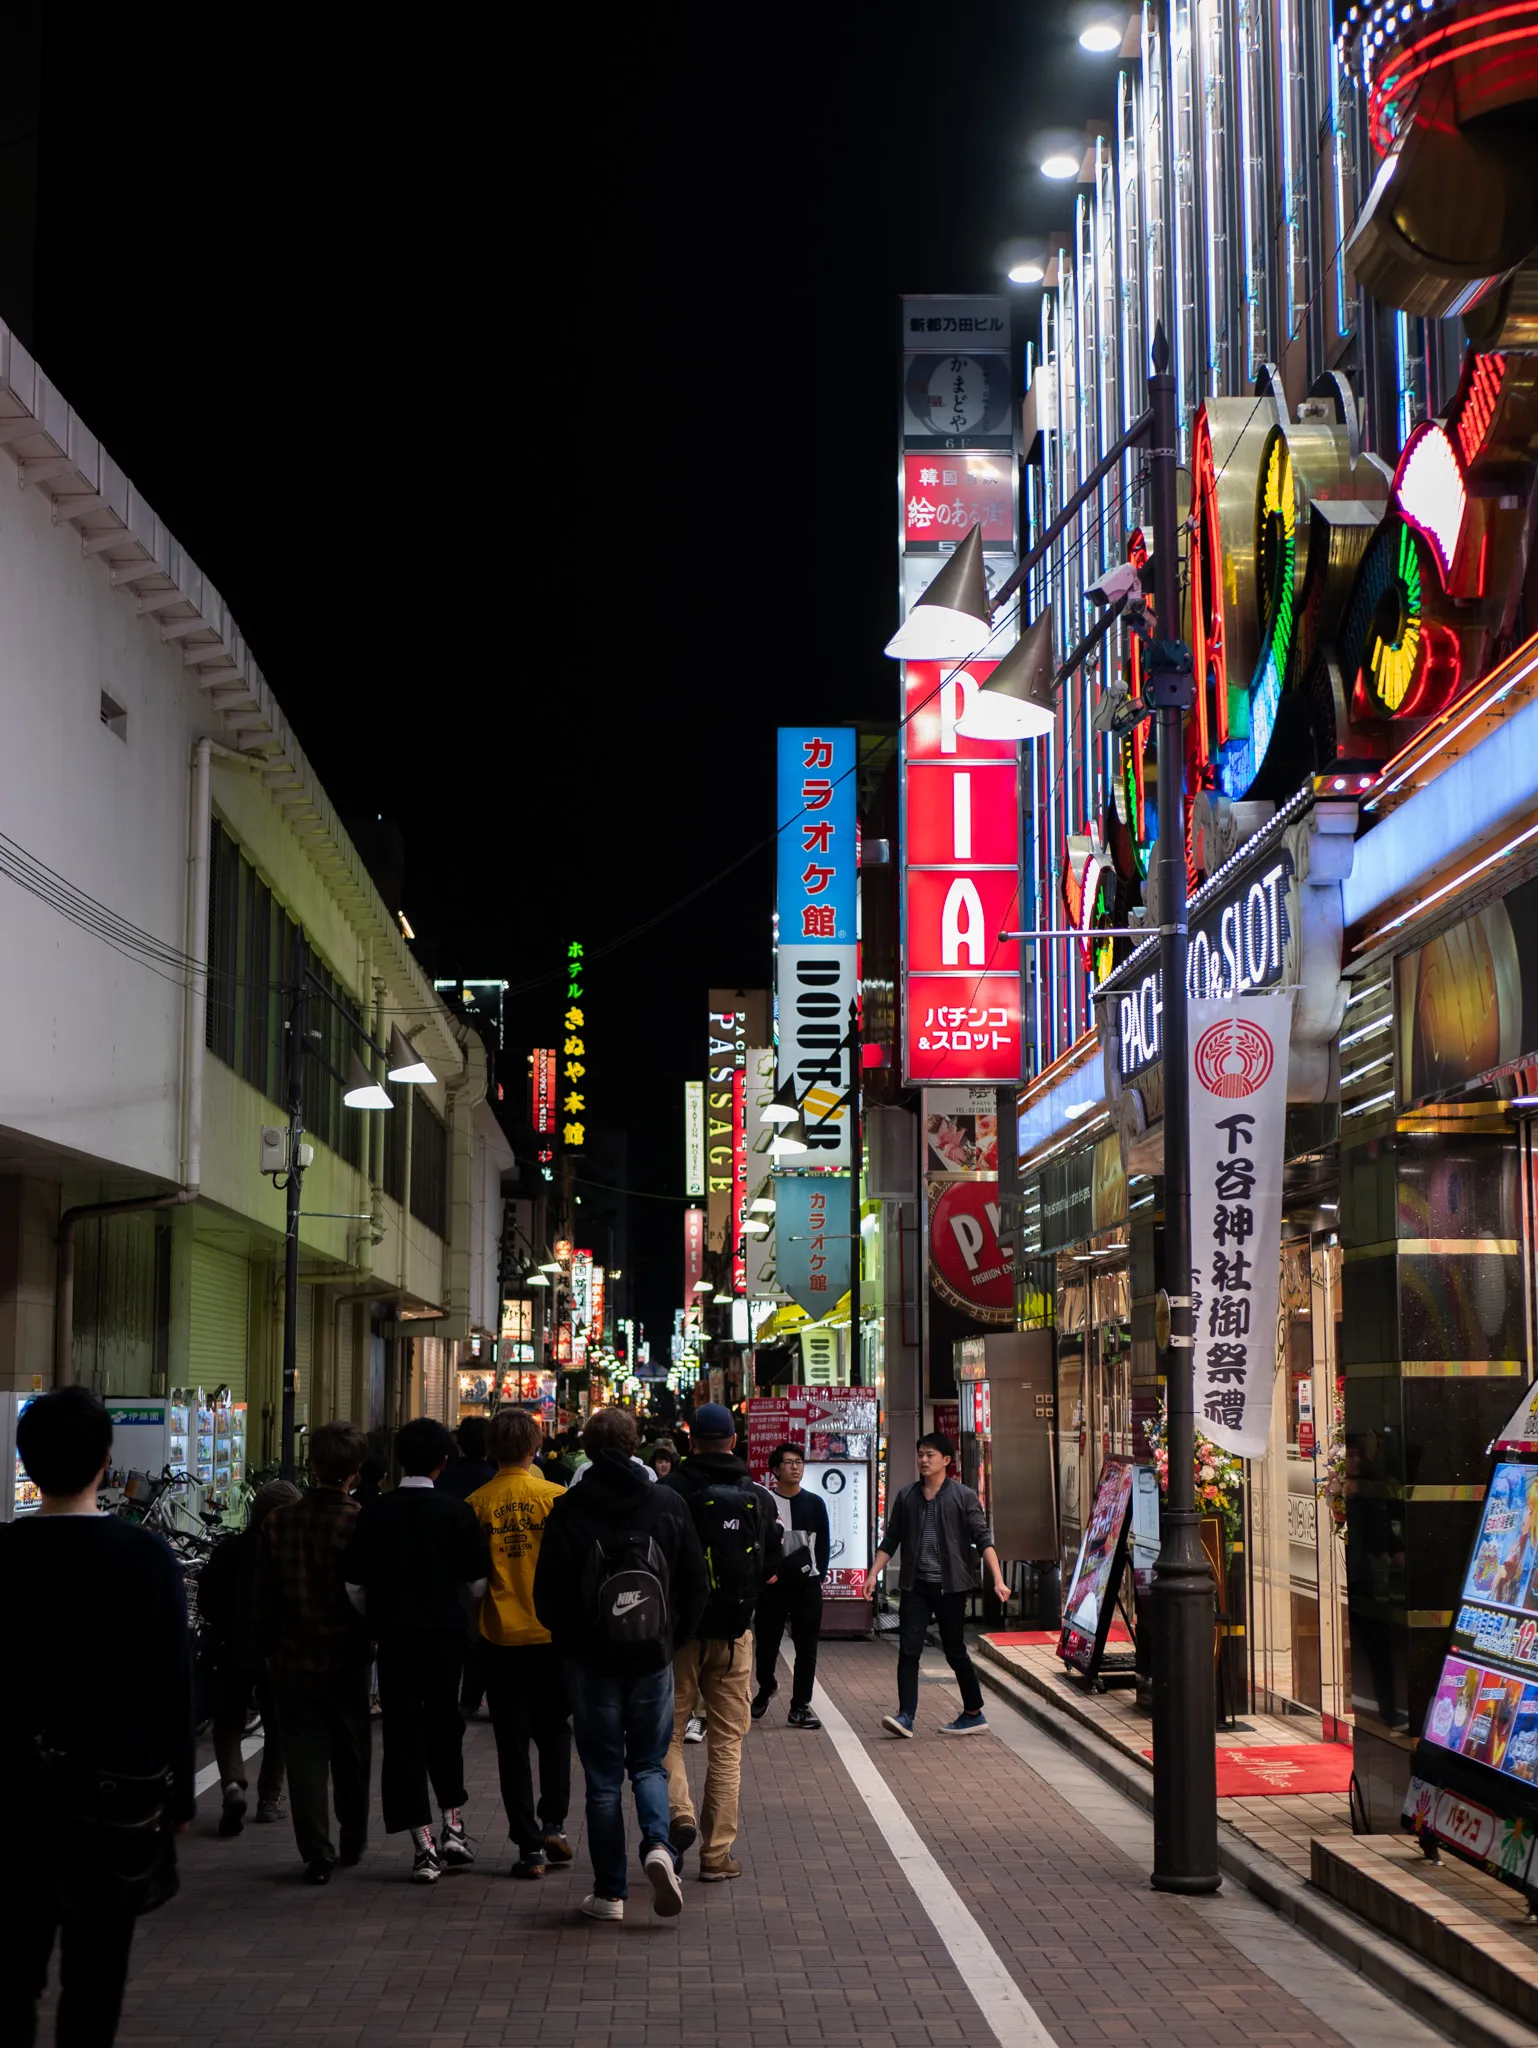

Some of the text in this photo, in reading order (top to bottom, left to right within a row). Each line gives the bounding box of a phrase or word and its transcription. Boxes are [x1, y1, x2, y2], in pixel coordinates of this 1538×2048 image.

[949, 356, 968, 433] かまどや
[801, 737, 836, 938] カラオケ館
[940, 668, 985, 965] PIA
[924, 1006, 1008, 1028] パチンコ
[796, 960, 847, 1151] DOUTOR
[918, 1030, 1012, 1050] &スロット
[709, 1011, 735, 1194] PASSAGE
[808, 1192, 828, 1292] カラオケ館
[971, 1267, 1001, 1286] FASHION
[1203, 1112, 1257, 1431] 下谷神社御祭禮
[810, 1338, 831, 1386] DOU
[127, 1411, 160, 1422] 伊藤園
[493, 1502, 535, 1519] GENERAL
[518, 1517, 547, 1533] Steal
[617, 1590, 642, 1606] NIKE
[1445, 1802, 1482, 1843] パチンコ
